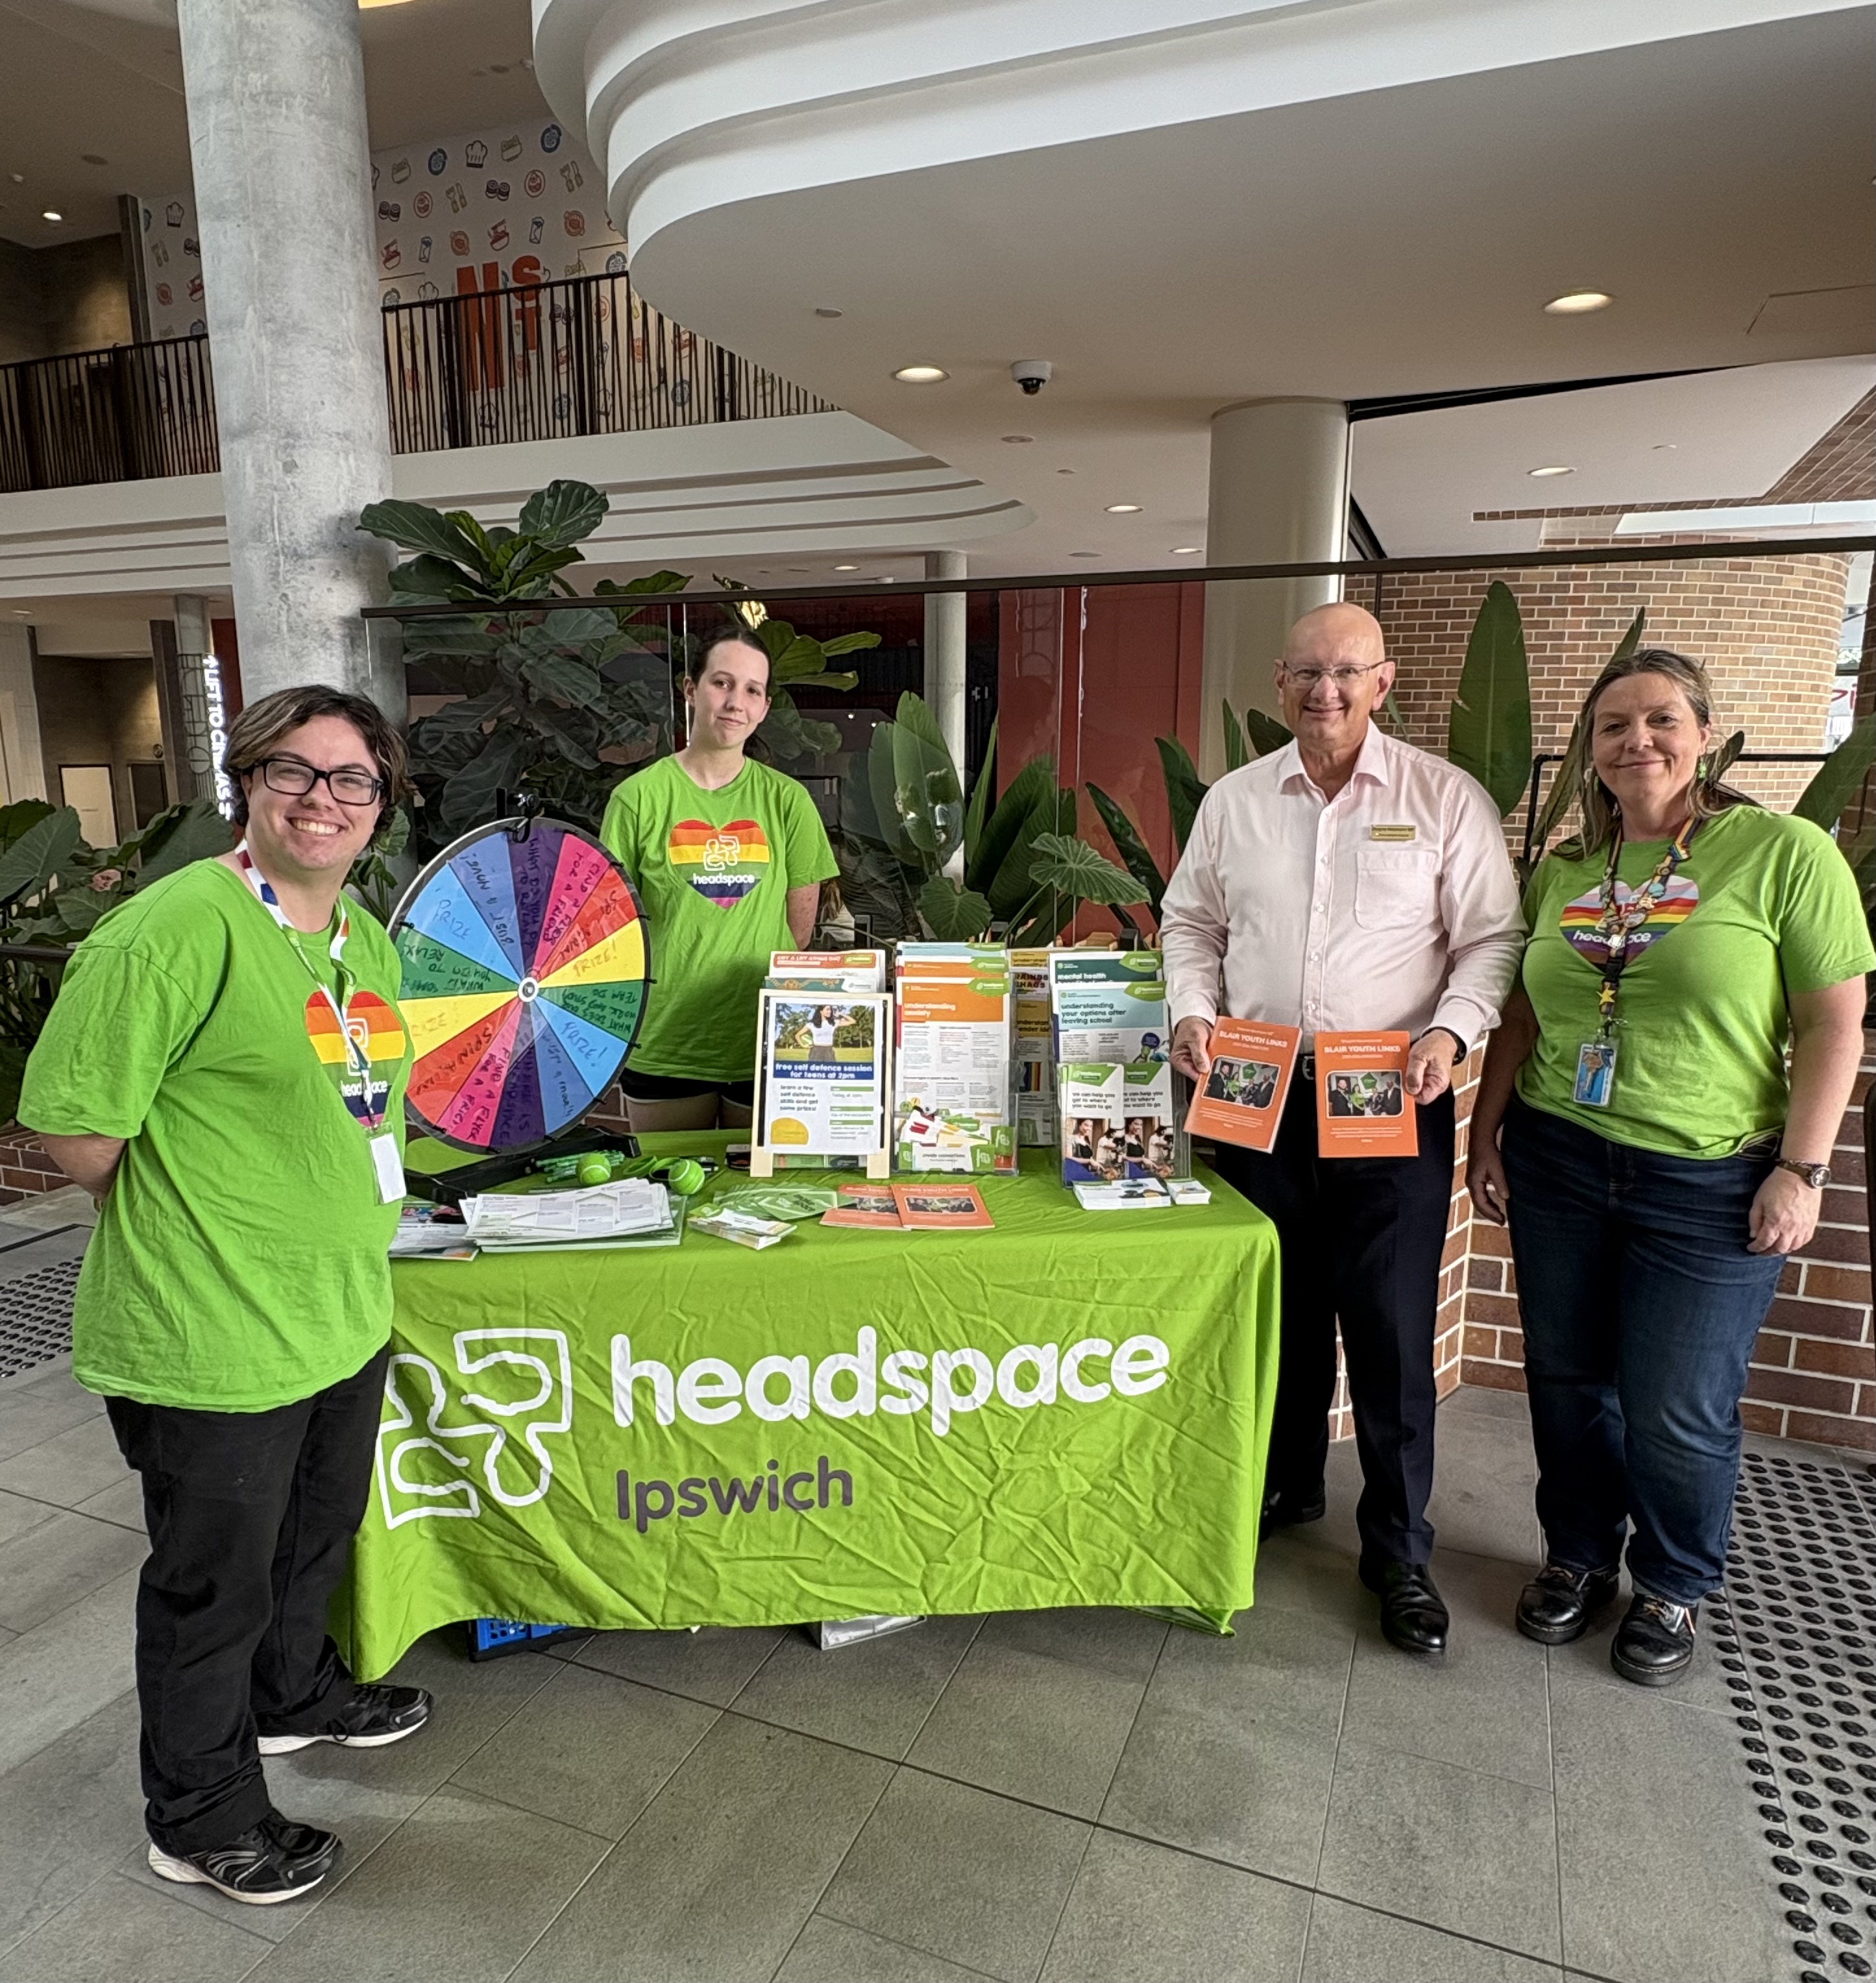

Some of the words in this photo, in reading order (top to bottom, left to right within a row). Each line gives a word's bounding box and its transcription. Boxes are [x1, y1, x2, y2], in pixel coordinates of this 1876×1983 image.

[204, 669, 222, 703] LIFT
[208, 704, 224, 727] TO
[692, 872, 755, 886] headspace
[432, 899, 469, 940] PRIZE
[573, 939, 618, 978] PRIZE!
[1219, 1030, 1240, 1040] BLAIR
[1241, 1034, 1265, 1044] YOUTH
[1266, 1038, 1288, 1048] LINKS
[340, 1080, 387, 1097] headace
[611, 1326, 1169, 1435] headspace
[615, 1455, 853, 1533] Ipswich
